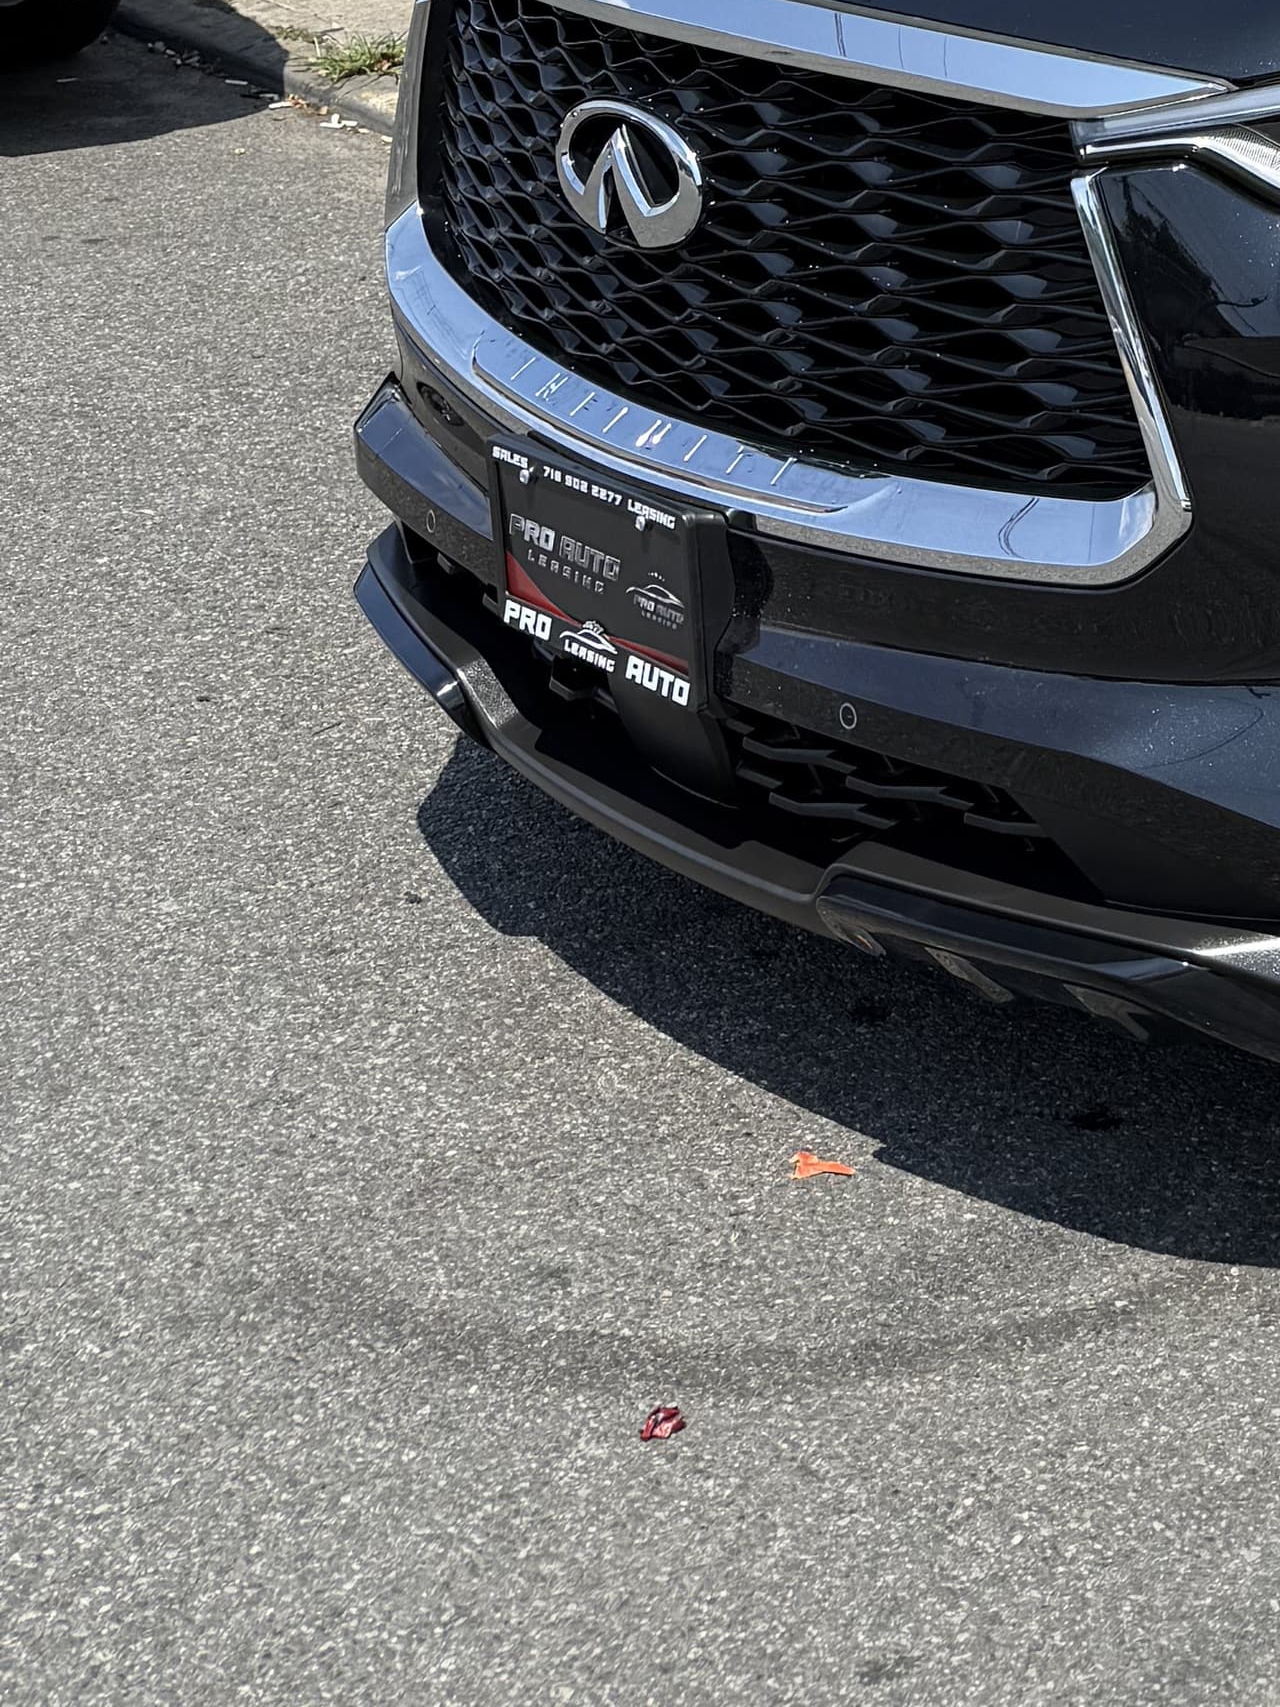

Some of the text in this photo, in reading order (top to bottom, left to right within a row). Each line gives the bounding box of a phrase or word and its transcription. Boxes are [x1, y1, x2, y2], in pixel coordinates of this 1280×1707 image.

[492, 445, 676, 530] SALES 718 902 2277 LEASING
[509, 513, 621, 582] PRO AUTO
[527, 548, 605, 595] LEASING
[503, 599, 691, 707] PRO LEASING AUTO
